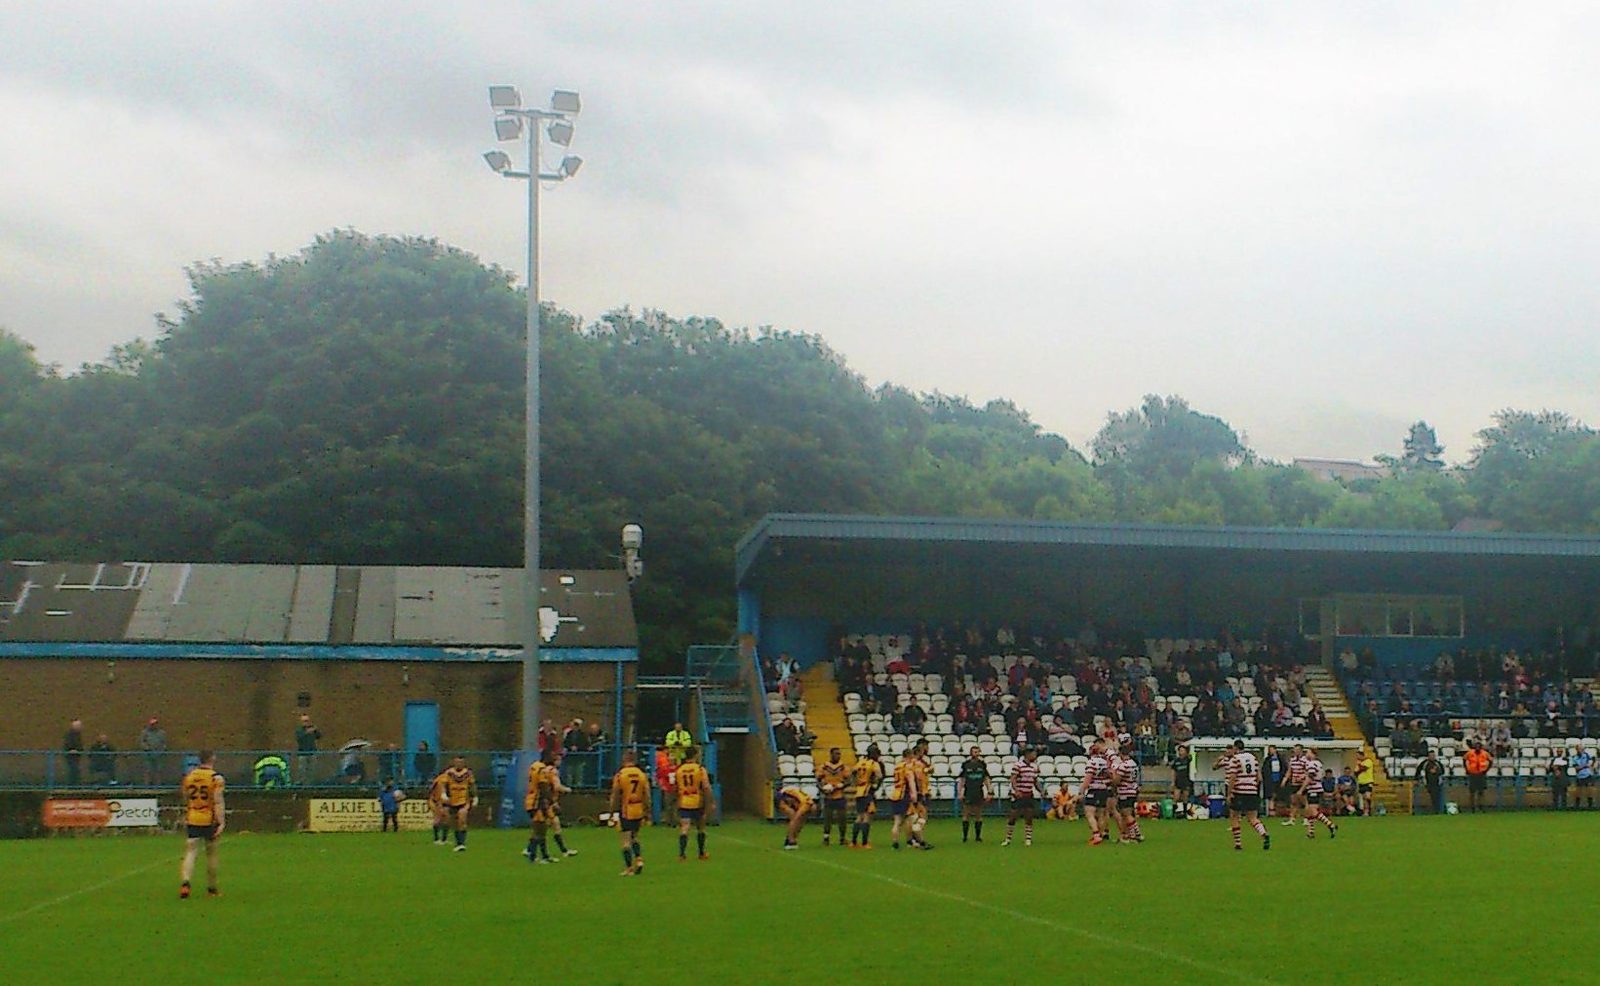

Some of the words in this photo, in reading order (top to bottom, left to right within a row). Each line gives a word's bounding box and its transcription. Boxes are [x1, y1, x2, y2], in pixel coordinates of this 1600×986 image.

[630, 780, 639, 794] 7
[683, 774, 695, 787] 11
[188, 785, 208, 800] 25
[319, 801, 367, 813] ALKIE
